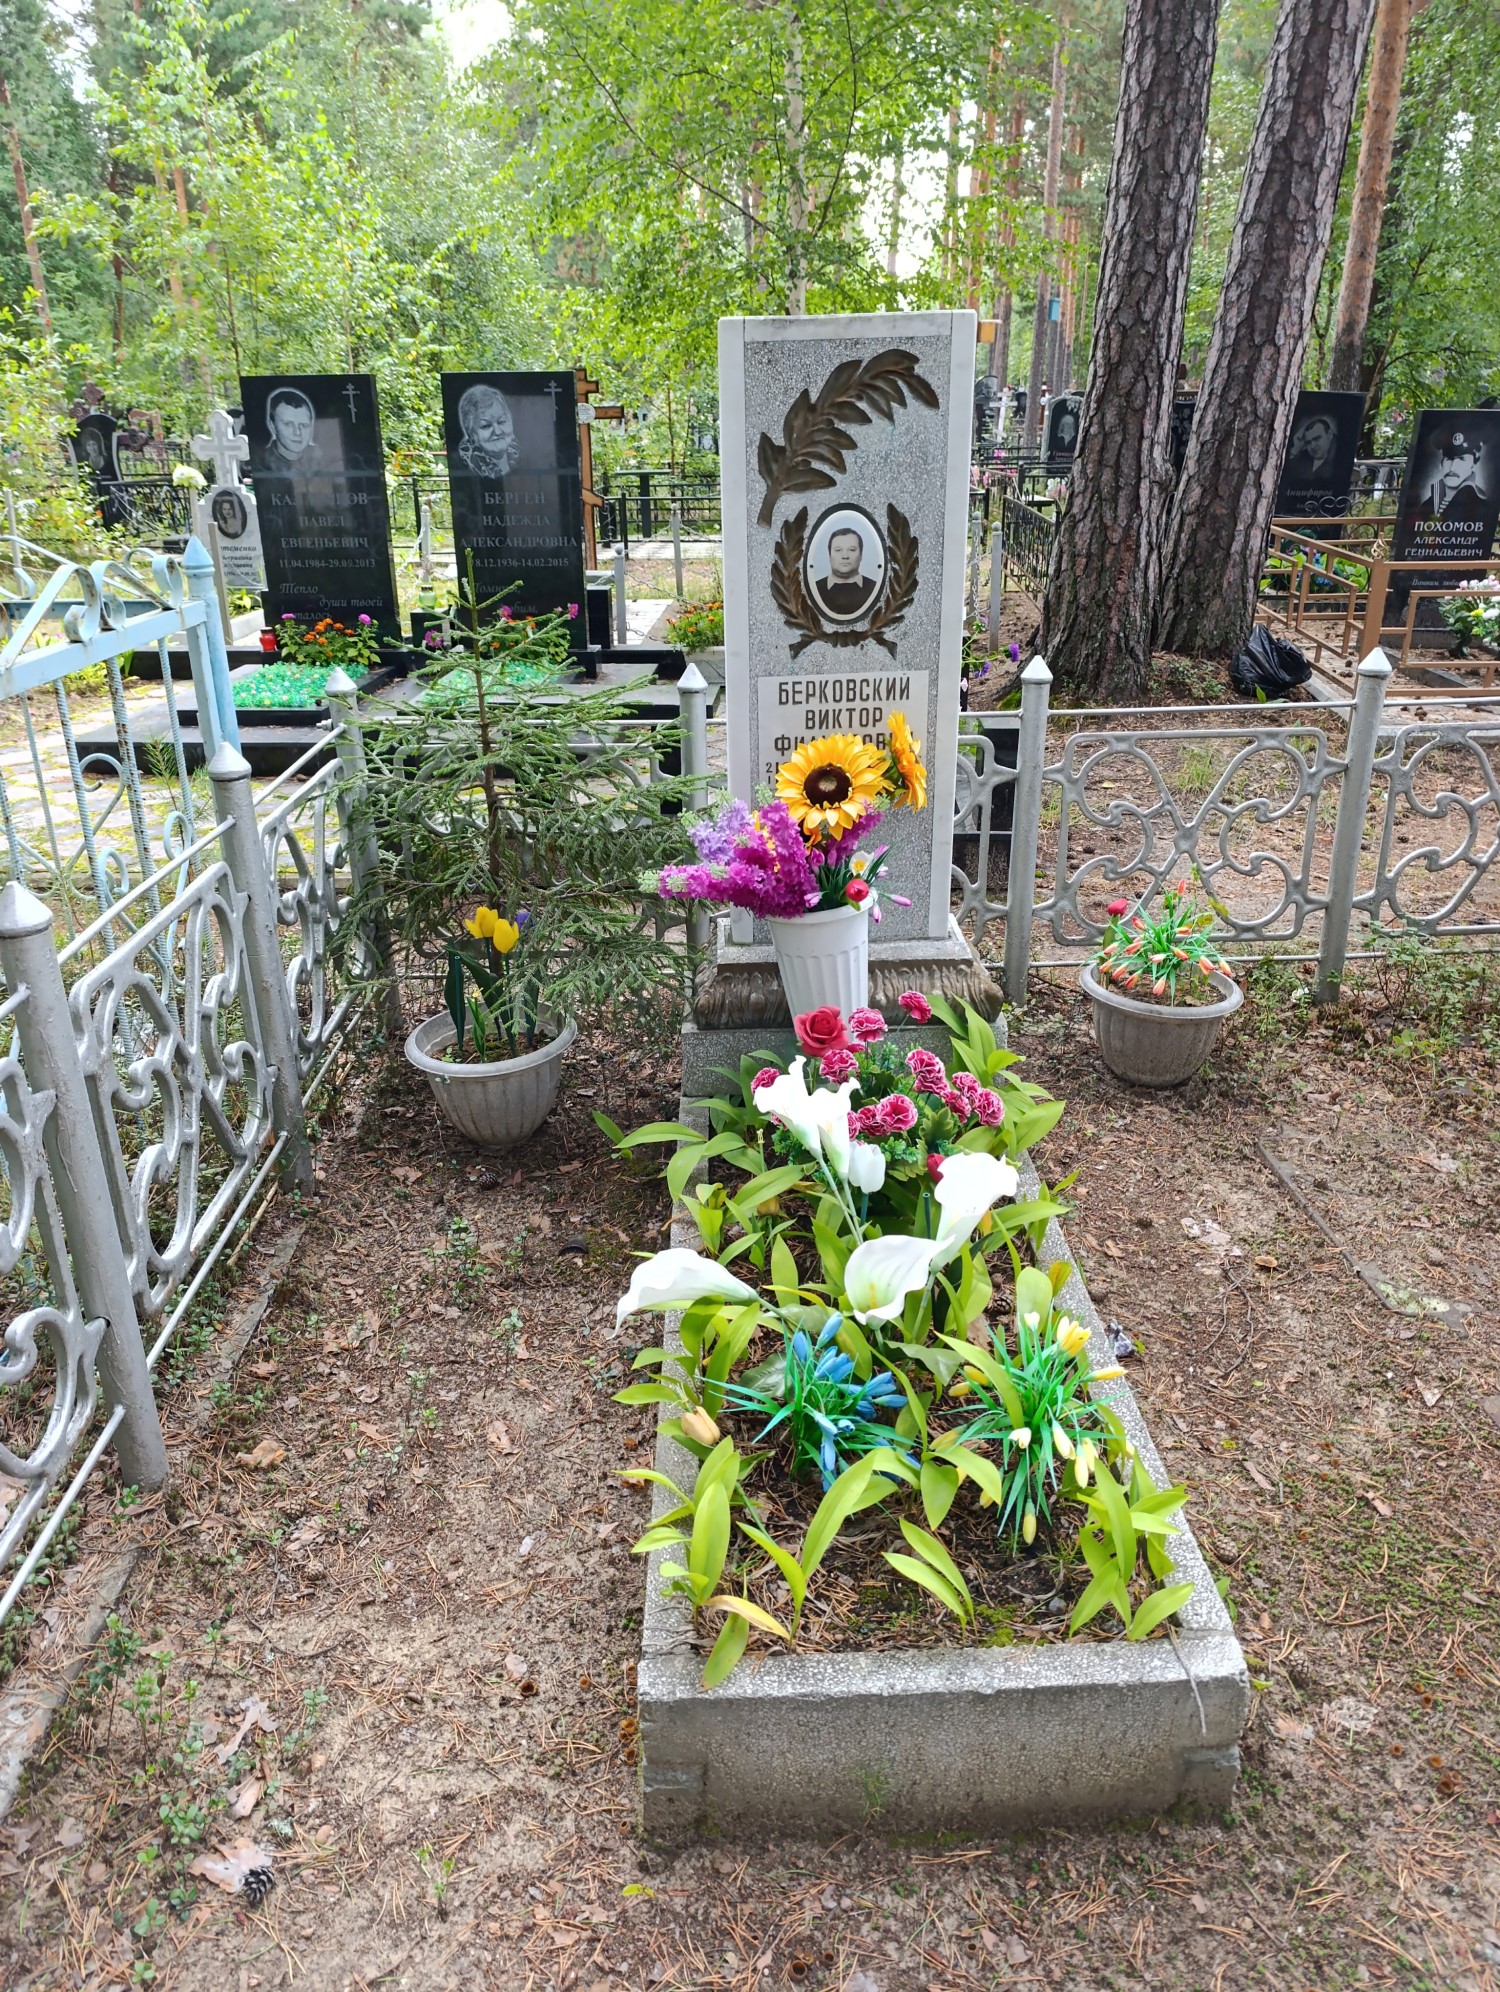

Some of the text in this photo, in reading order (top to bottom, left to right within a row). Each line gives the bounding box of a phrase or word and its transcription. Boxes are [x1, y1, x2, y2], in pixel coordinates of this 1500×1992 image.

[299, 515, 345, 527] ПАВЕЛ
[482, 515, 550, 527] НАДЕЖДА
[1414, 521, 1484, 532] ПОХОМОВ
[281, 536, 369, 549] ЕВГЕНЬЕВИЧ
[460, 536, 578, 549] АЛЕКСАНДРОВНА
[1413, 536, 1479, 545] АЛЕКСАНДР
[1404, 548, 1483, 557] ГЕННАДЬЕВИЧ
[280, 558, 376, 569] 11.04.1984-29.09.2013
[471, 558, 569, 568] 8.12.1936-14.02.2015
[280, 582, 318, 594] Тепло
[319, 594, 383, 610] души твоей
[778, 672, 910, 706] БЕРКОВСКИЙ
[805, 707, 883, 730] ВИКТОР
